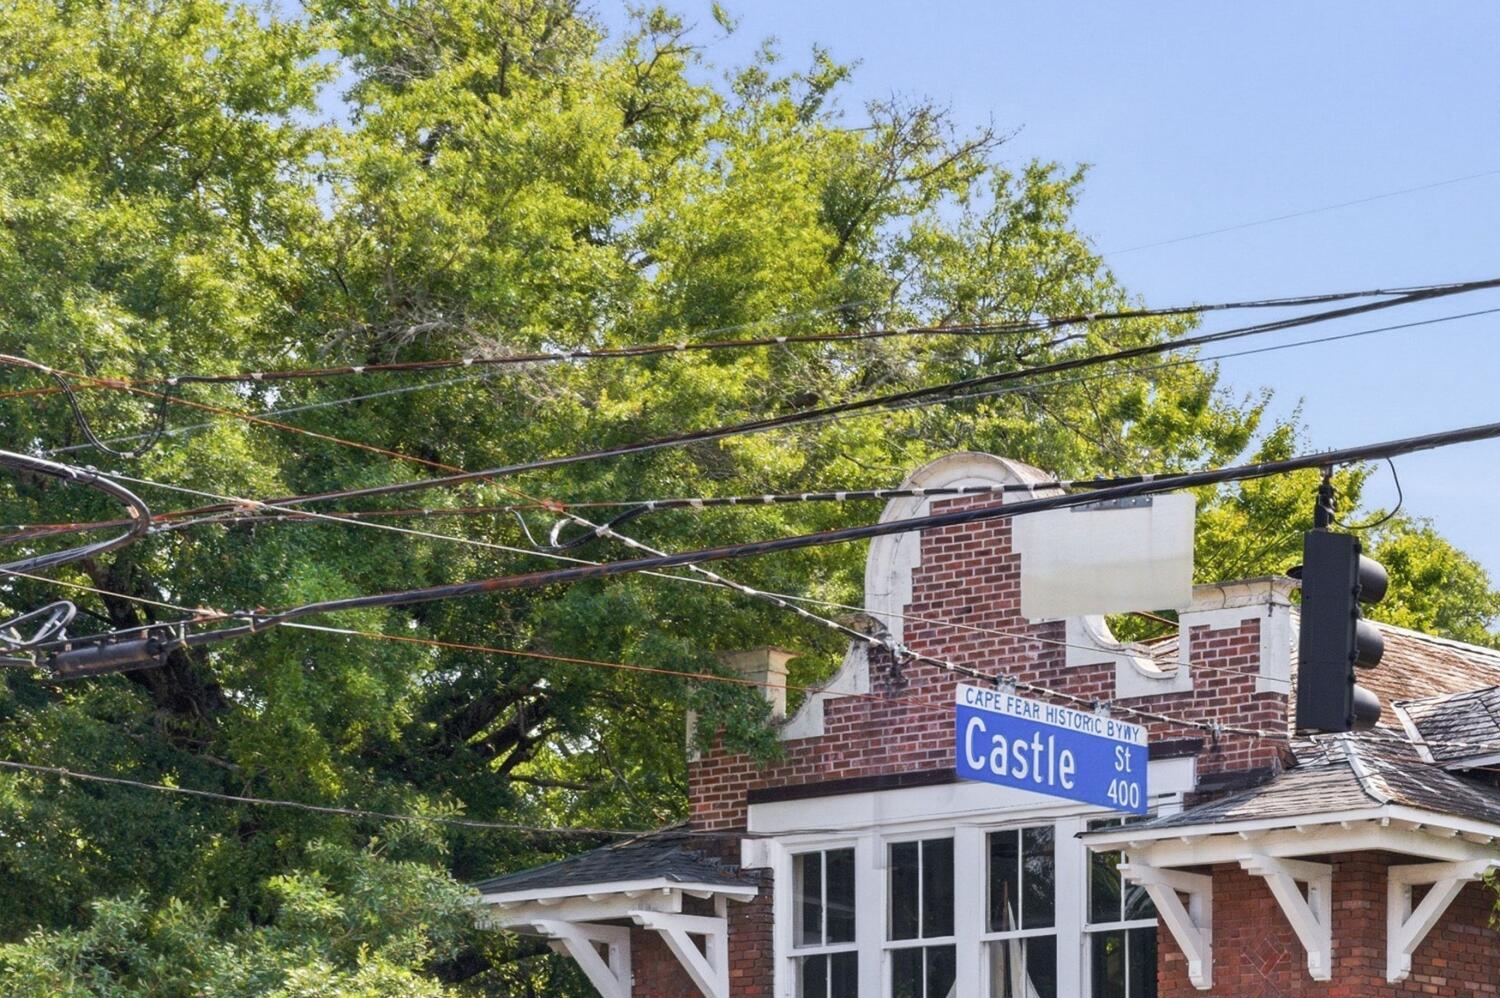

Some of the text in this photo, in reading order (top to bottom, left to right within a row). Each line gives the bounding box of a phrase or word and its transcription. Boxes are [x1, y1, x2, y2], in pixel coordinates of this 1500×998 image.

[965, 687, 1139, 743] CAPE FEAR HISTORIC BYWY
[965, 716, 1132, 790] Castle St
[1107, 778, 1139, 809] 400
